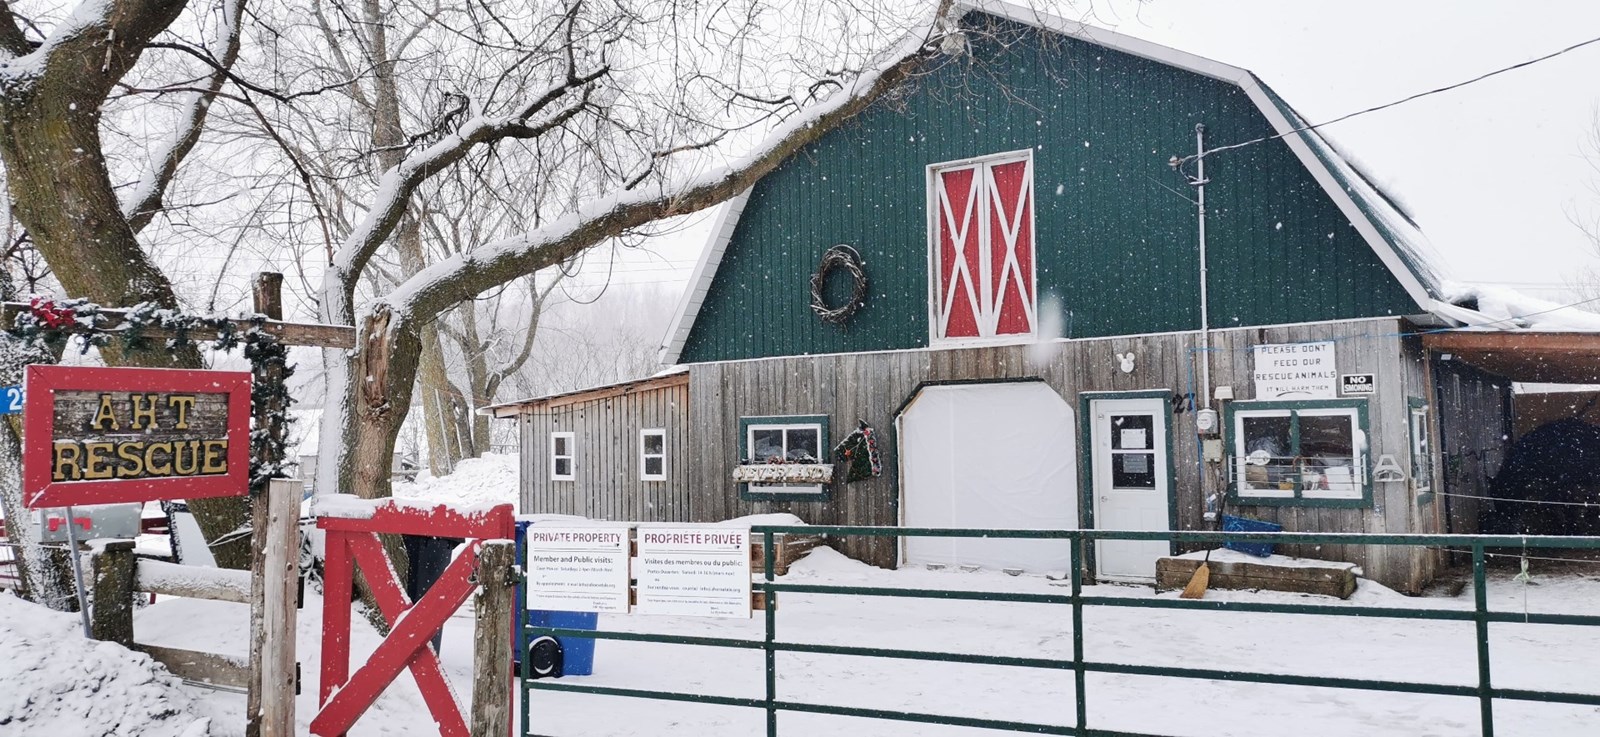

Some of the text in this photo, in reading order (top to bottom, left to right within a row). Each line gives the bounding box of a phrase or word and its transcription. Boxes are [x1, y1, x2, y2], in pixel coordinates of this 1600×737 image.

[1261, 346, 1297, 354] PLEASE
[1273, 358, 1321, 367] FEED OUR
[1255, 371, 1336, 380] RESCUE ANIMALS
[1344, 376, 1373, 391] NO SMOKING
[53, 439, 228, 480] RESCUE
[533, 532, 621, 543] PRIVATE PROPERTY
[644, 530, 743, 545] PROPRIÉTÉ PRIVÉE
[594, 556, 613, 564] visits:
[722, 560, 743, 568] public:
